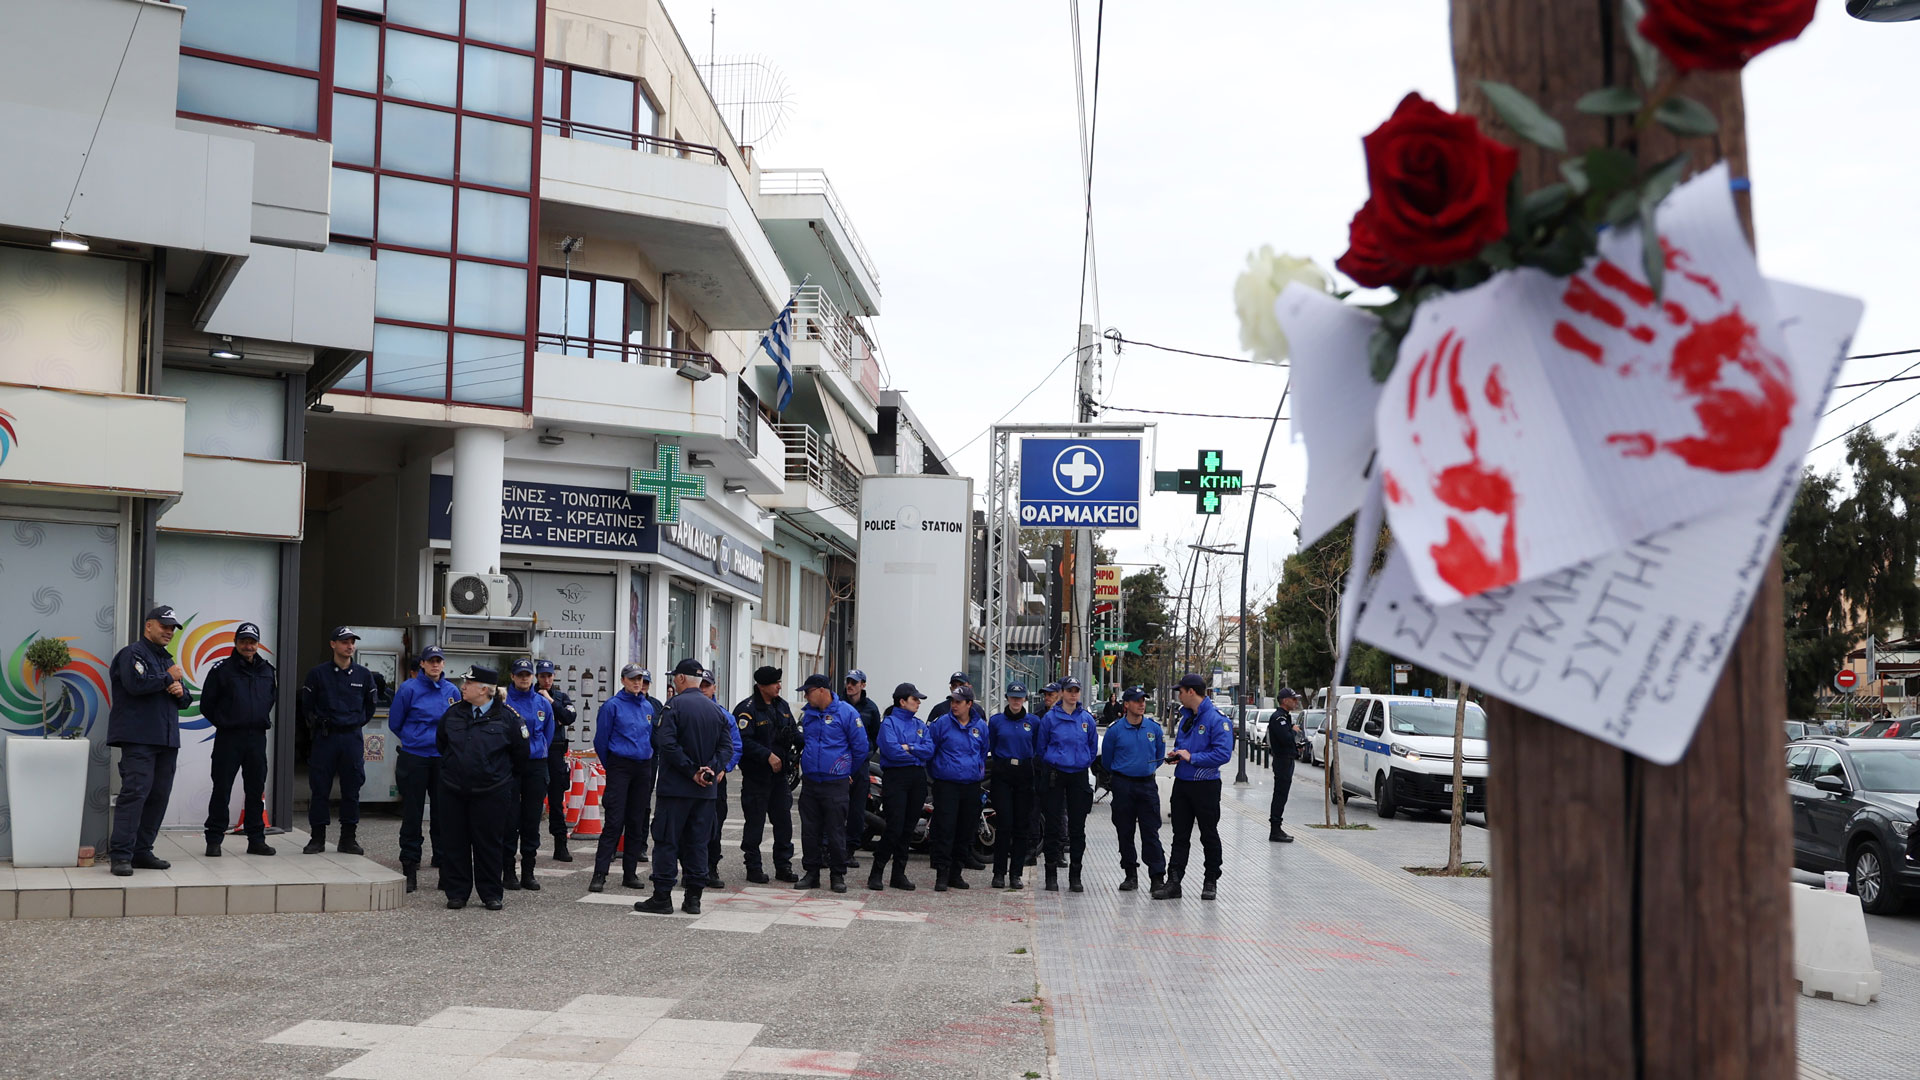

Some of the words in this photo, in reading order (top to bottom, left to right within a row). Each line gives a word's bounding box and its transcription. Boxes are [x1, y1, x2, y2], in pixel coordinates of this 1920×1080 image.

[1199, 475, 1241, 488] ΚΤΗΝ
[503, 485, 546, 503] ΕΪΝΕΣ
[560, 491, 632, 511] ΤΟΝΩΤΙΚΑ
[501, 505, 552, 522] ΑΛΥΤΕΣ
[567, 510, 645, 529] ΚΡΕΑΤΙΝΕΣ
[1021, 504, 1138, 524] ΦΑΡΜΑΚΕΙΟ
[864, 519, 896, 531] POLICE
[921, 520, 962, 533] STATION
[500, 523, 532, 539] ΞΕΑ
[547, 527, 638, 547] ΕΝΕΡΓΕΙΑΚΑ
[734, 549, 765, 585] PHARMACY
[1096, 570, 1115, 580] ΗΡΙΟ
[561, 609, 586, 624] Sky
[544, 627, 602, 640] Premium
[560, 644, 585, 656] Life
